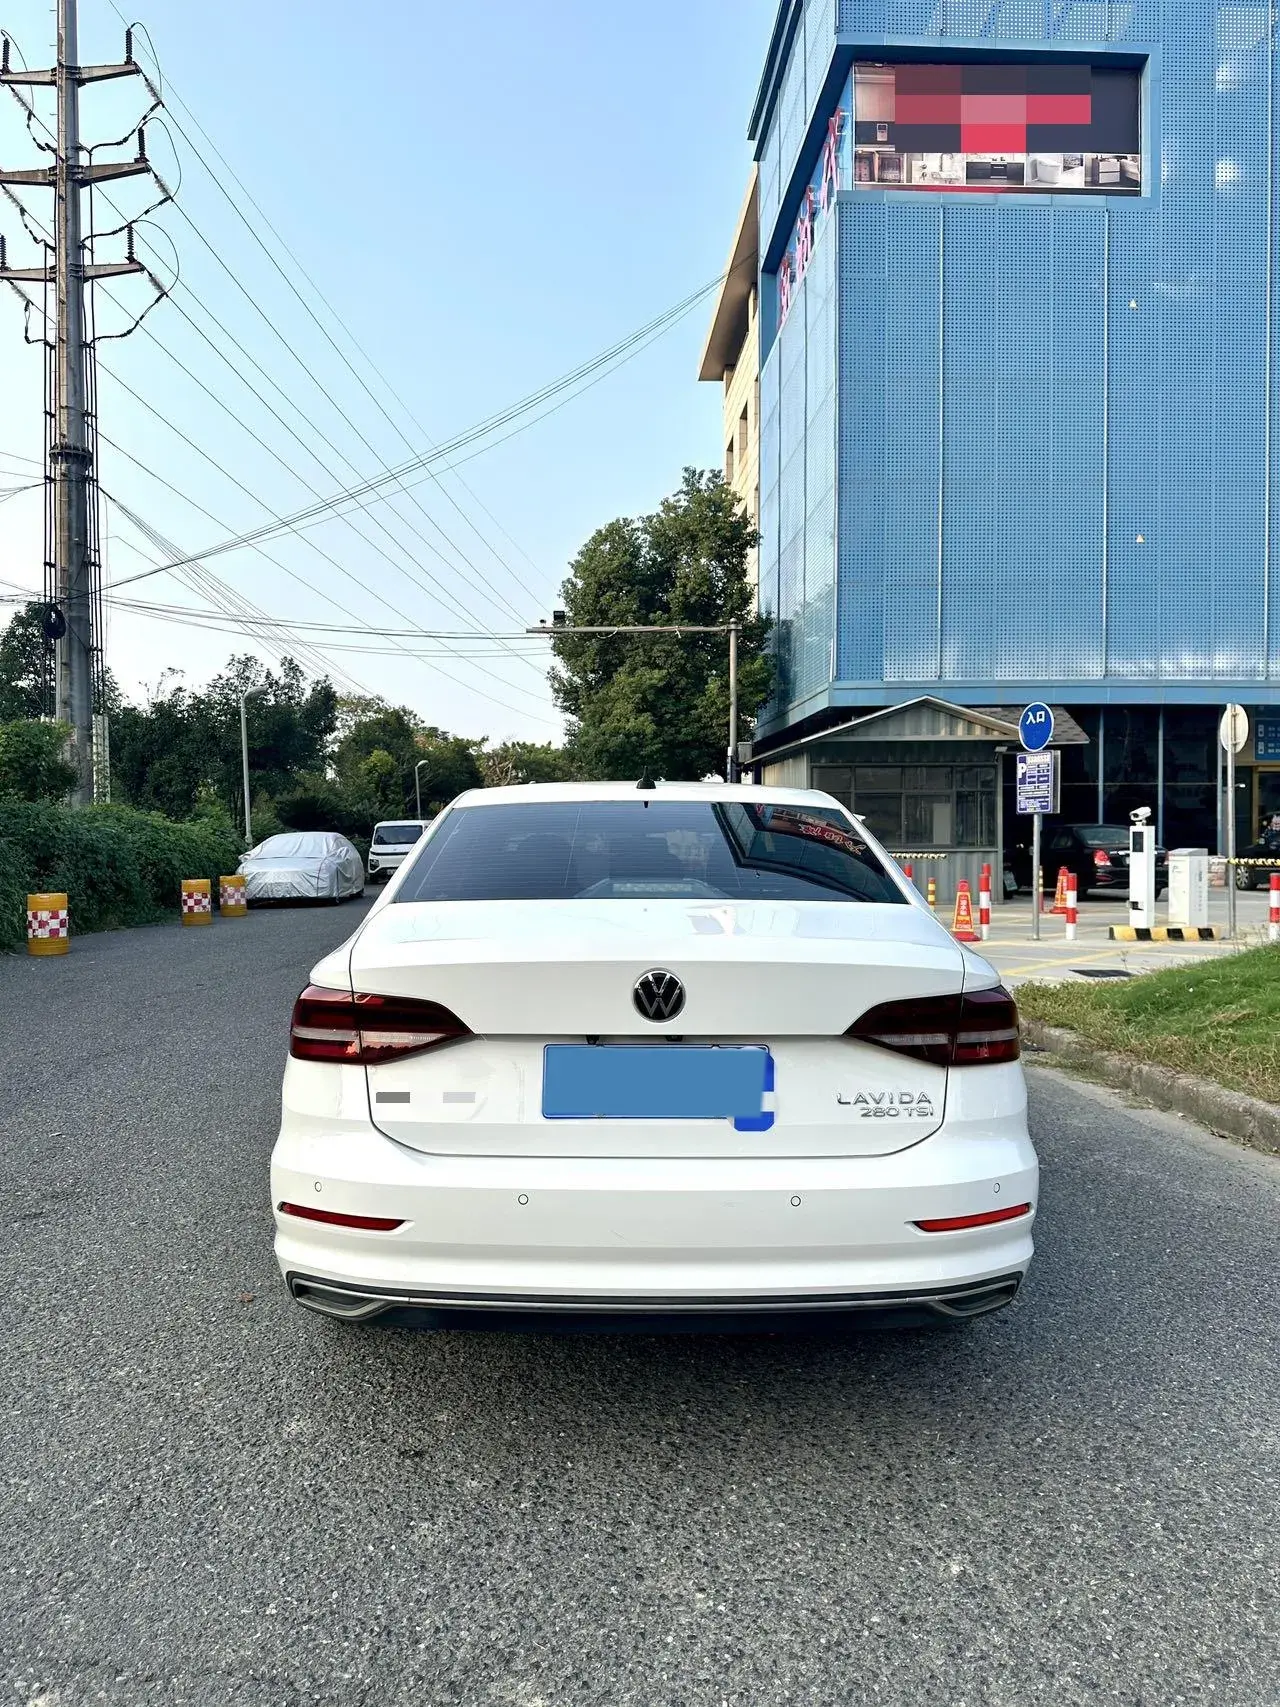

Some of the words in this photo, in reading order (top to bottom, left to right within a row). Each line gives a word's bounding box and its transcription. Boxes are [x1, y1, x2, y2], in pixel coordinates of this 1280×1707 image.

[1026, 710, 1046, 725] 入口
[1018, 762, 1028, 779] P
[836, 1091, 932, 1105] LAVIDA
[859, 1106, 900, 1118] 280
[903, 1105, 934, 1117] TSI
